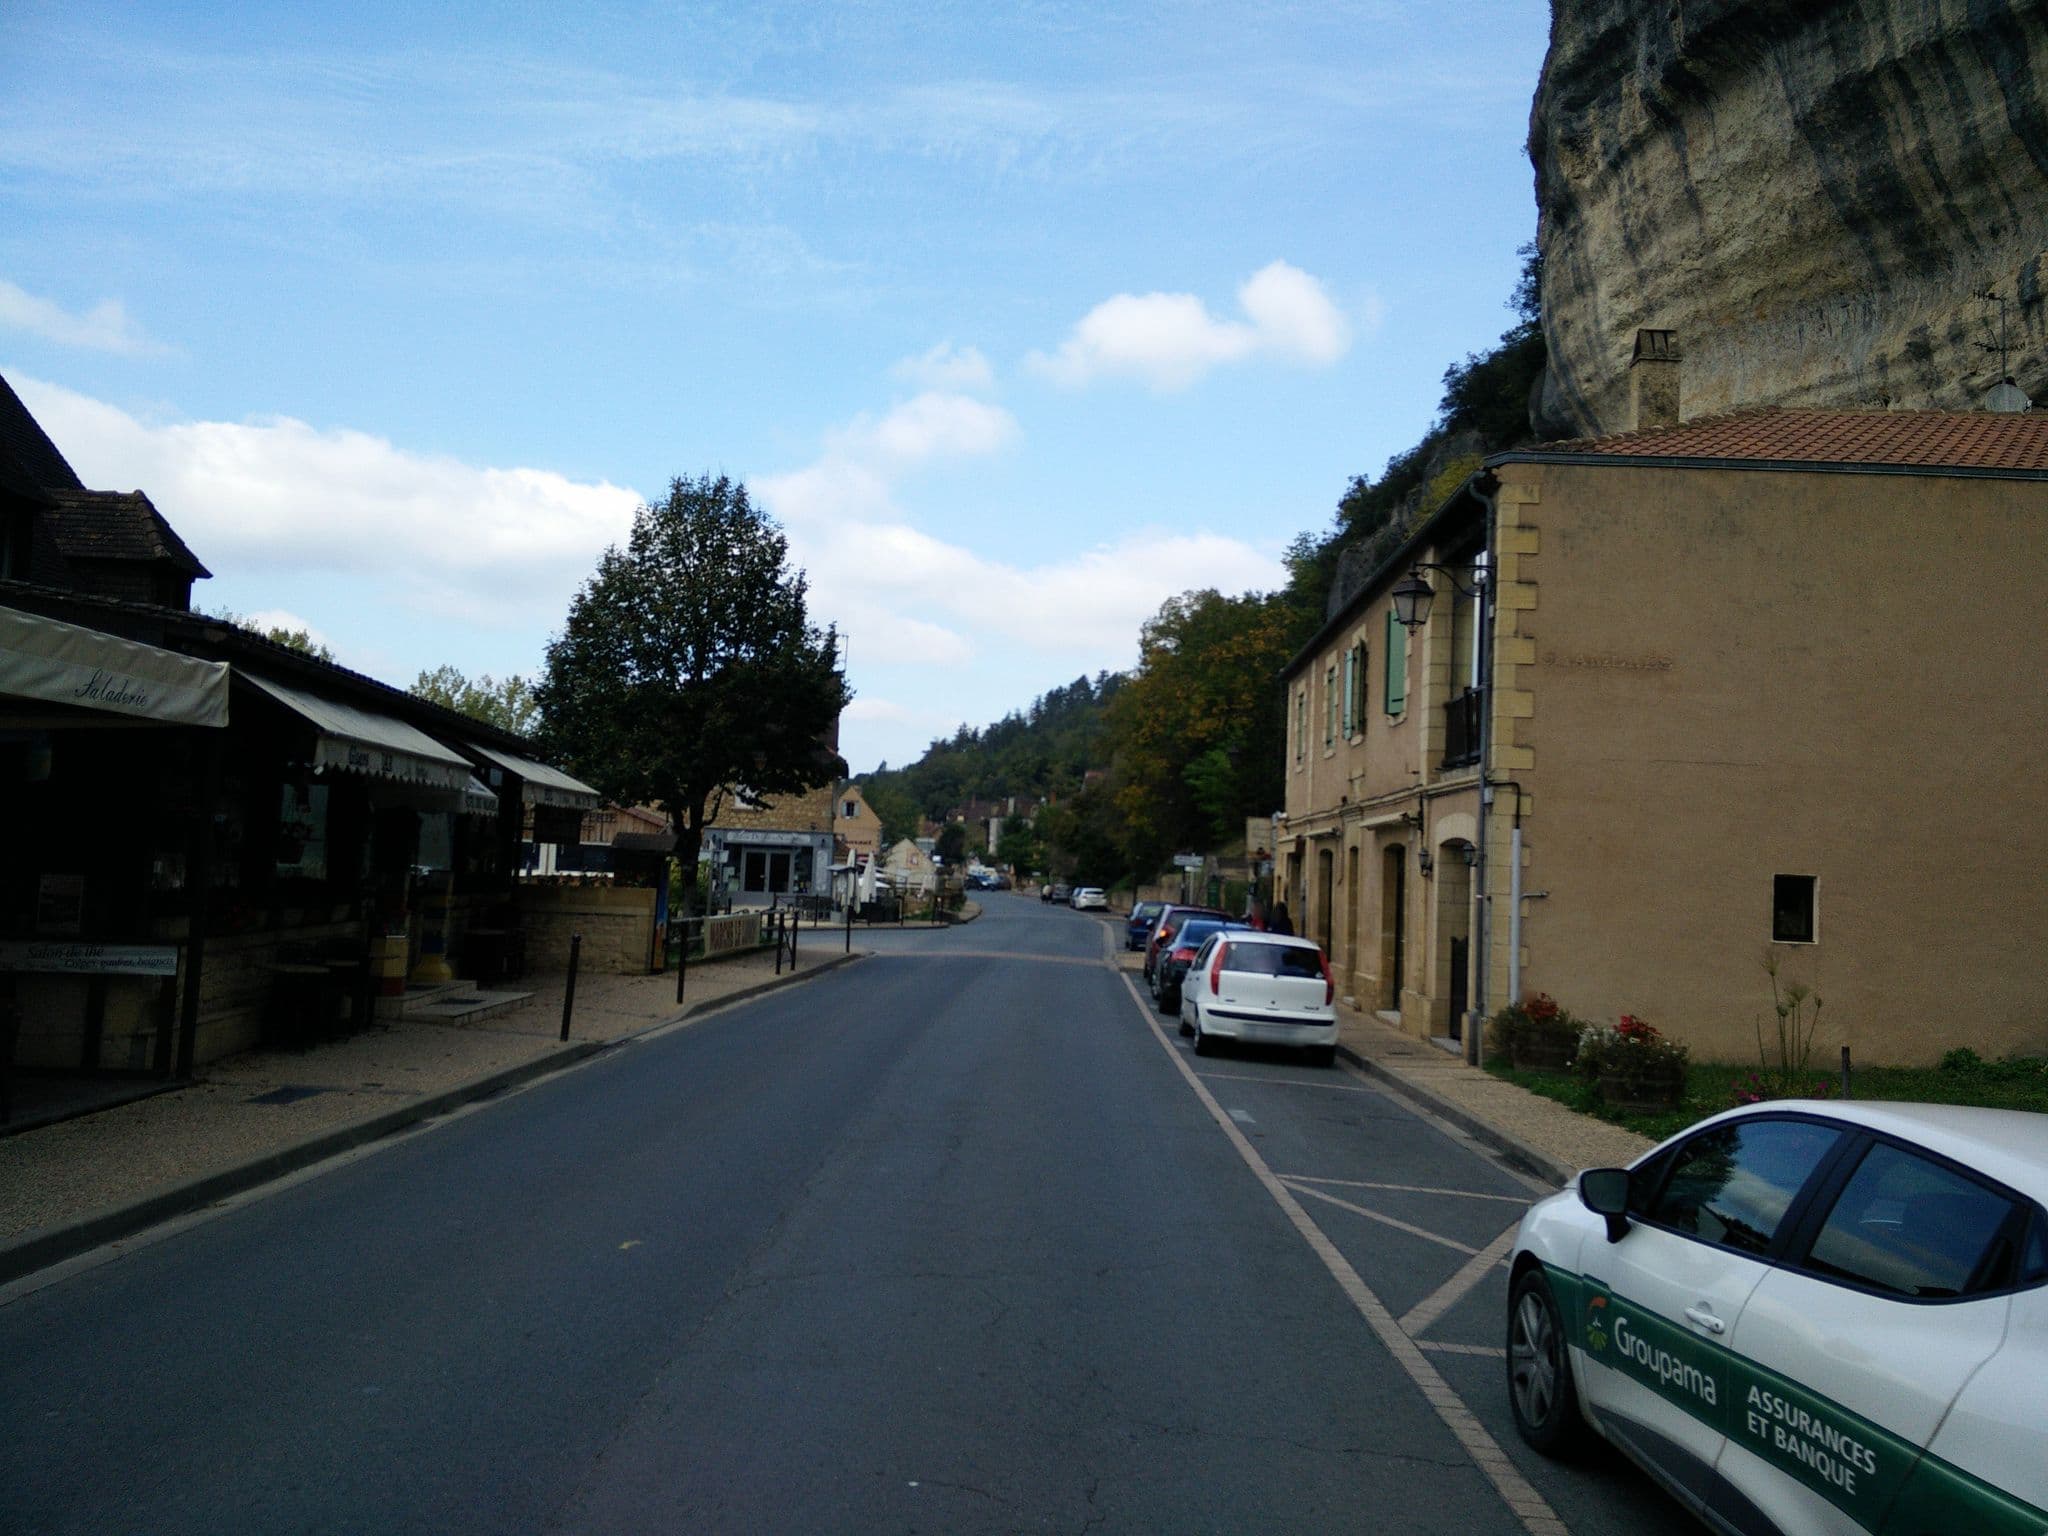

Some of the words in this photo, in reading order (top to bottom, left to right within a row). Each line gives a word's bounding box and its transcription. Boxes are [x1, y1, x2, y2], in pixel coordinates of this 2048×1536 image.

[74, 667, 147, 706] Saladerie
[1614, 1316, 1717, 1406] Groupama
[1747, 1384, 1877, 1476] ASSURANCES
[1747, 1411, 1769, 1438] ET
[1774, 1425, 1857, 1496] BANQUE
